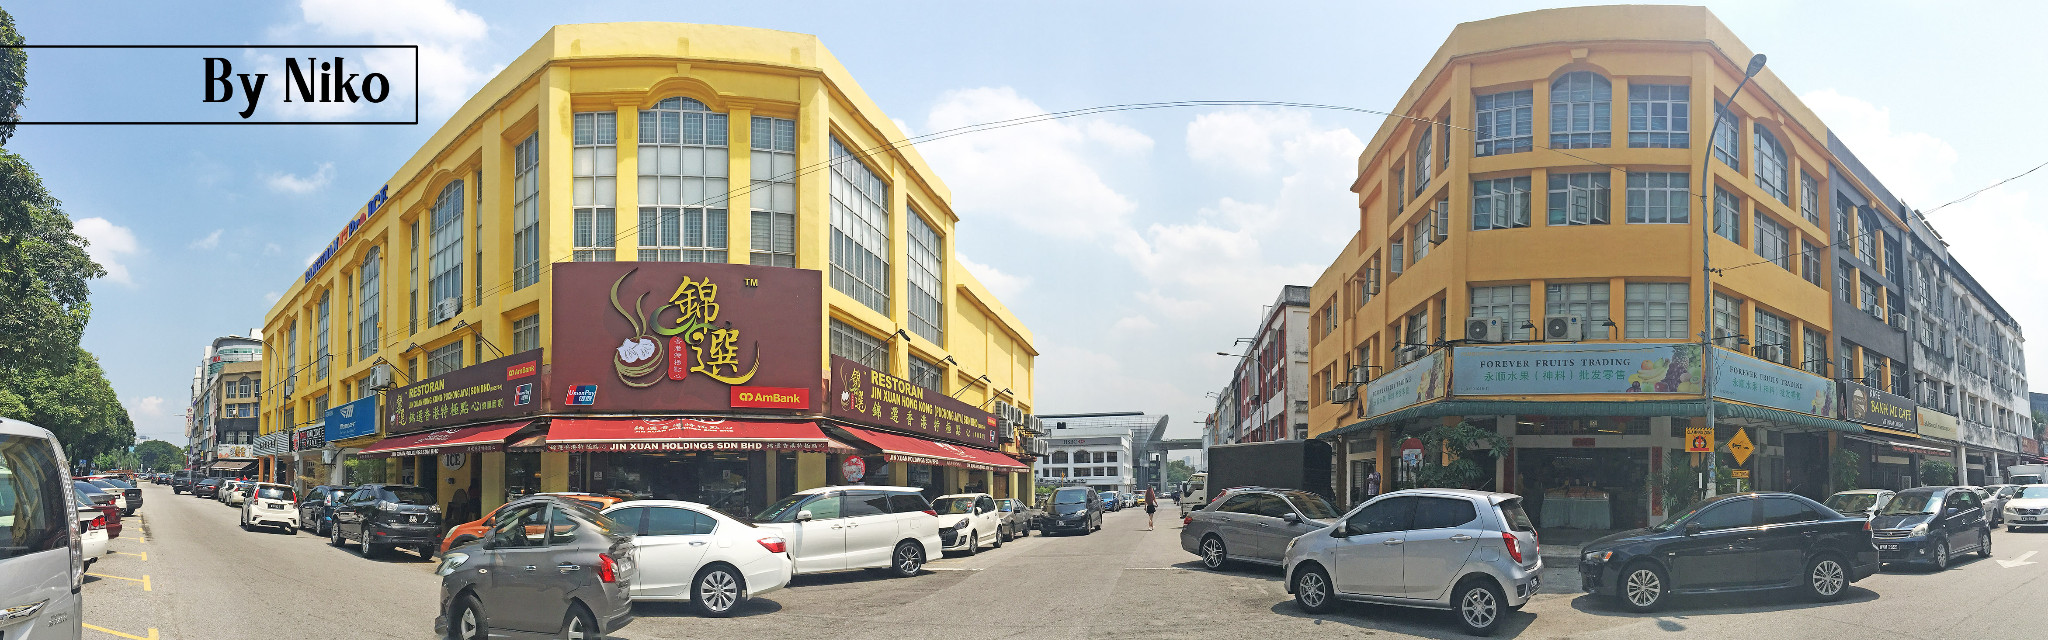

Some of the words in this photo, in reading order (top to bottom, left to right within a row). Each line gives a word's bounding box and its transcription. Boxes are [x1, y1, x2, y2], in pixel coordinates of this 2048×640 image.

[367, 183, 389, 219] ICE
[744, 278, 758, 287] TM
[1479, 360, 1530, 369] FOREVER
[1535, 359, 1575, 368] FRUITS
[1580, 358, 1631, 367] TRADING
[408, 378, 445, 399] RESTORAN
[871, 370, 924, 400] RESTORAN
[754, 392, 800, 404] AmBank
[870, 386, 882, 400] JIN
[883, 389, 901, 406] XUAN
[901, 395, 918, 411] HONG
[918, 401, 933, 415] KONG
[1889, 405, 1898, 418] MI
[1898, 407, 1912, 422] CAFE
[609, 443, 627, 451] JIN
[661, 442, 714, 450] HOLDINGS
[716, 442, 739, 450] SDN
[741, 442, 763, 450] BHD
[446, 454, 461, 467] ICE
[402, 475, 414, 485] IC
